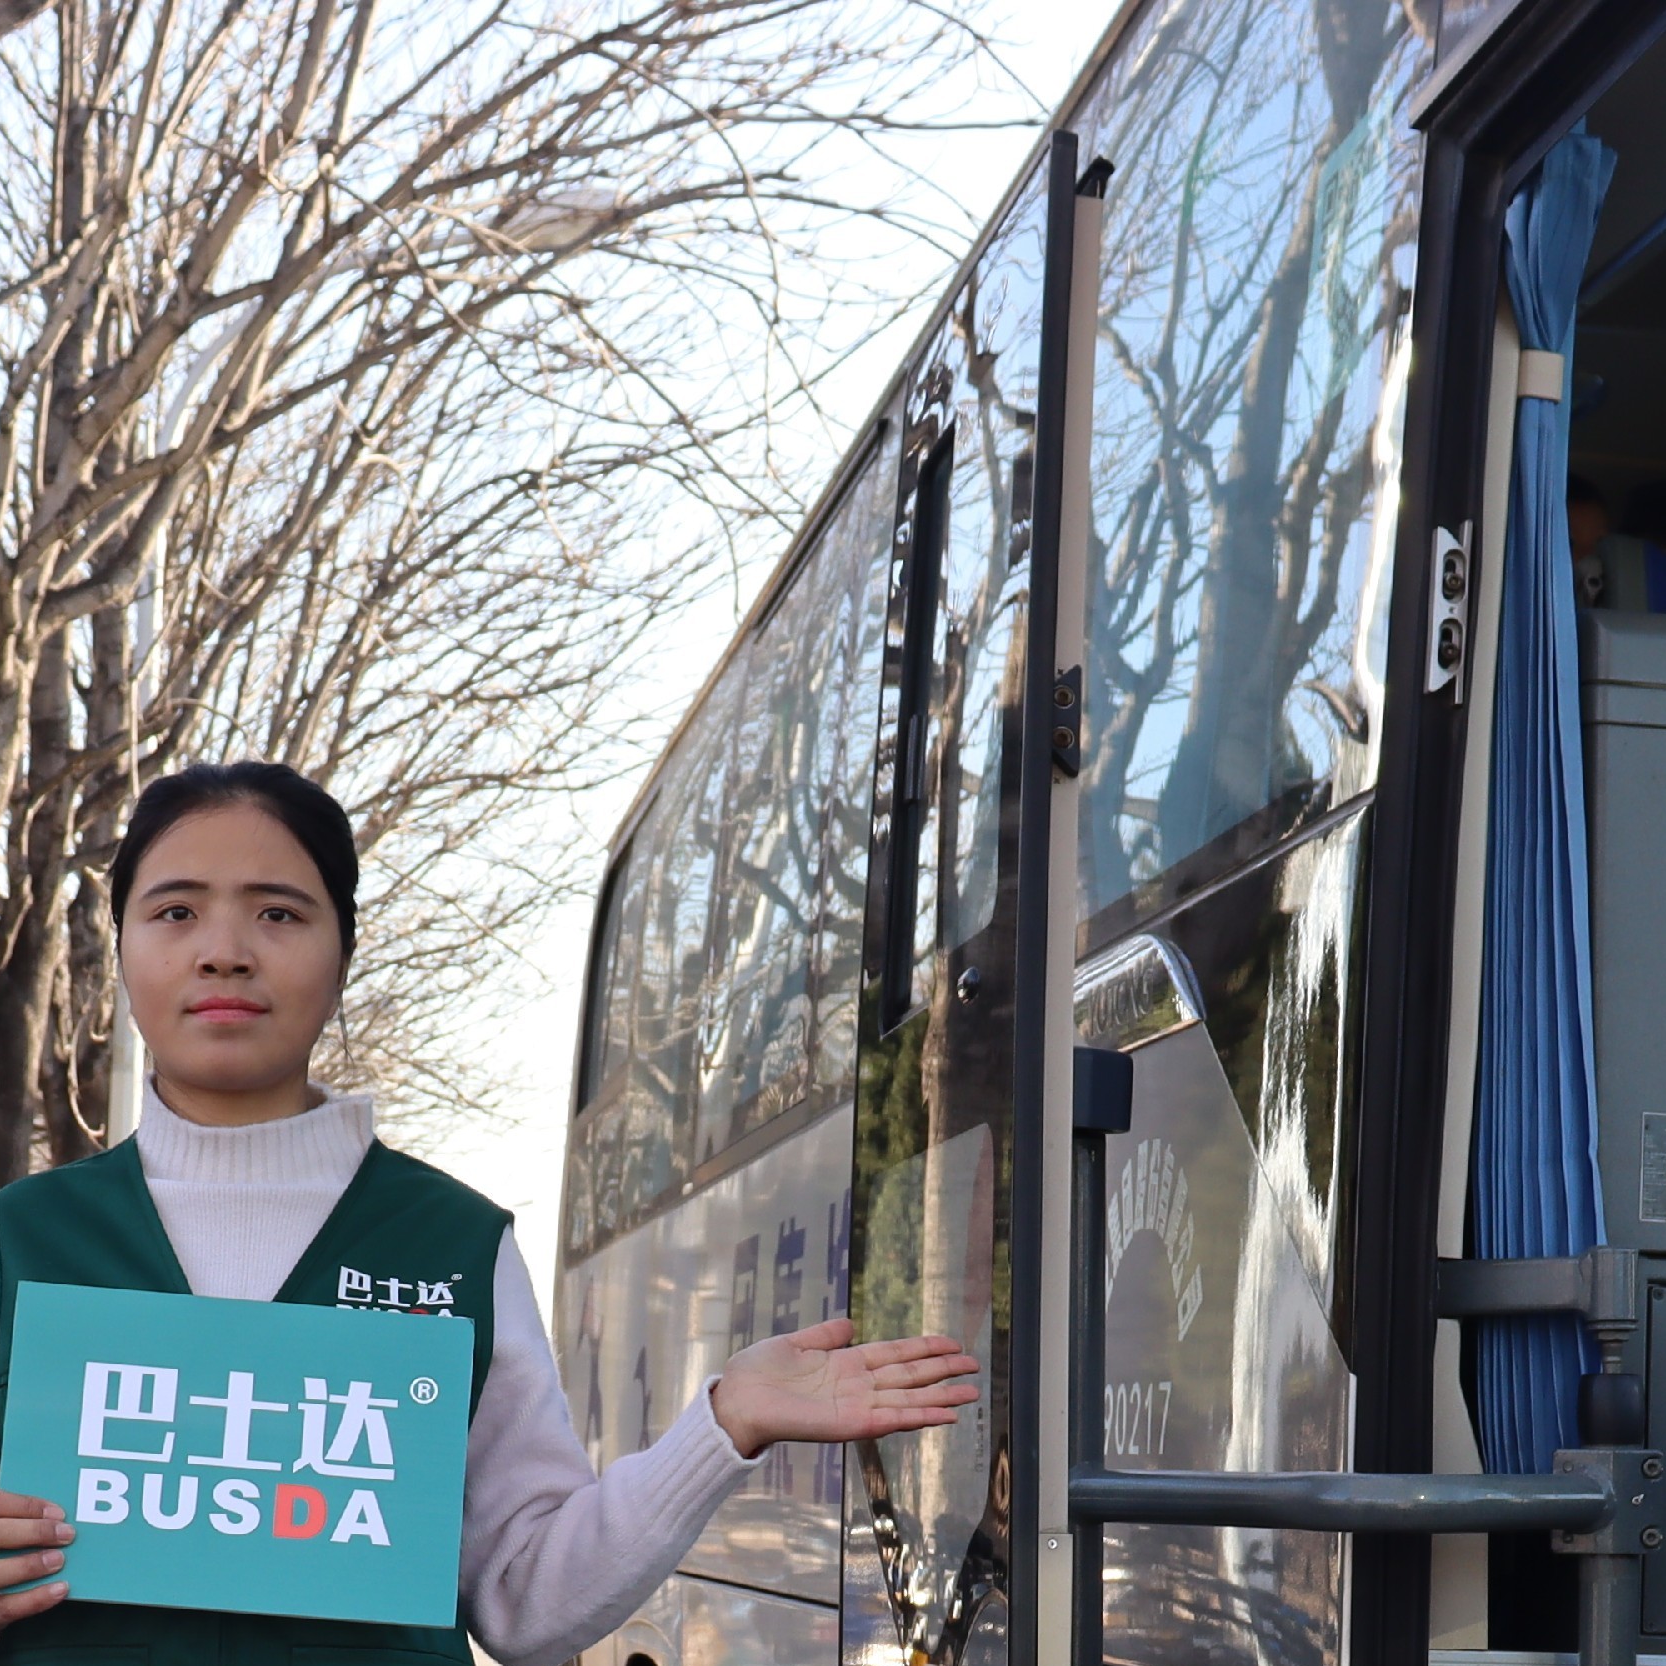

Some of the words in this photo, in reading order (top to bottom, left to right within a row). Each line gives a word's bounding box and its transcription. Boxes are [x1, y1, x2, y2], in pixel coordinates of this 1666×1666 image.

[337, 1265, 455, 1308] 巴士达
[76, 1360, 400, 1481] 巴士达
[75, 1467, 392, 1548] BUSDA
